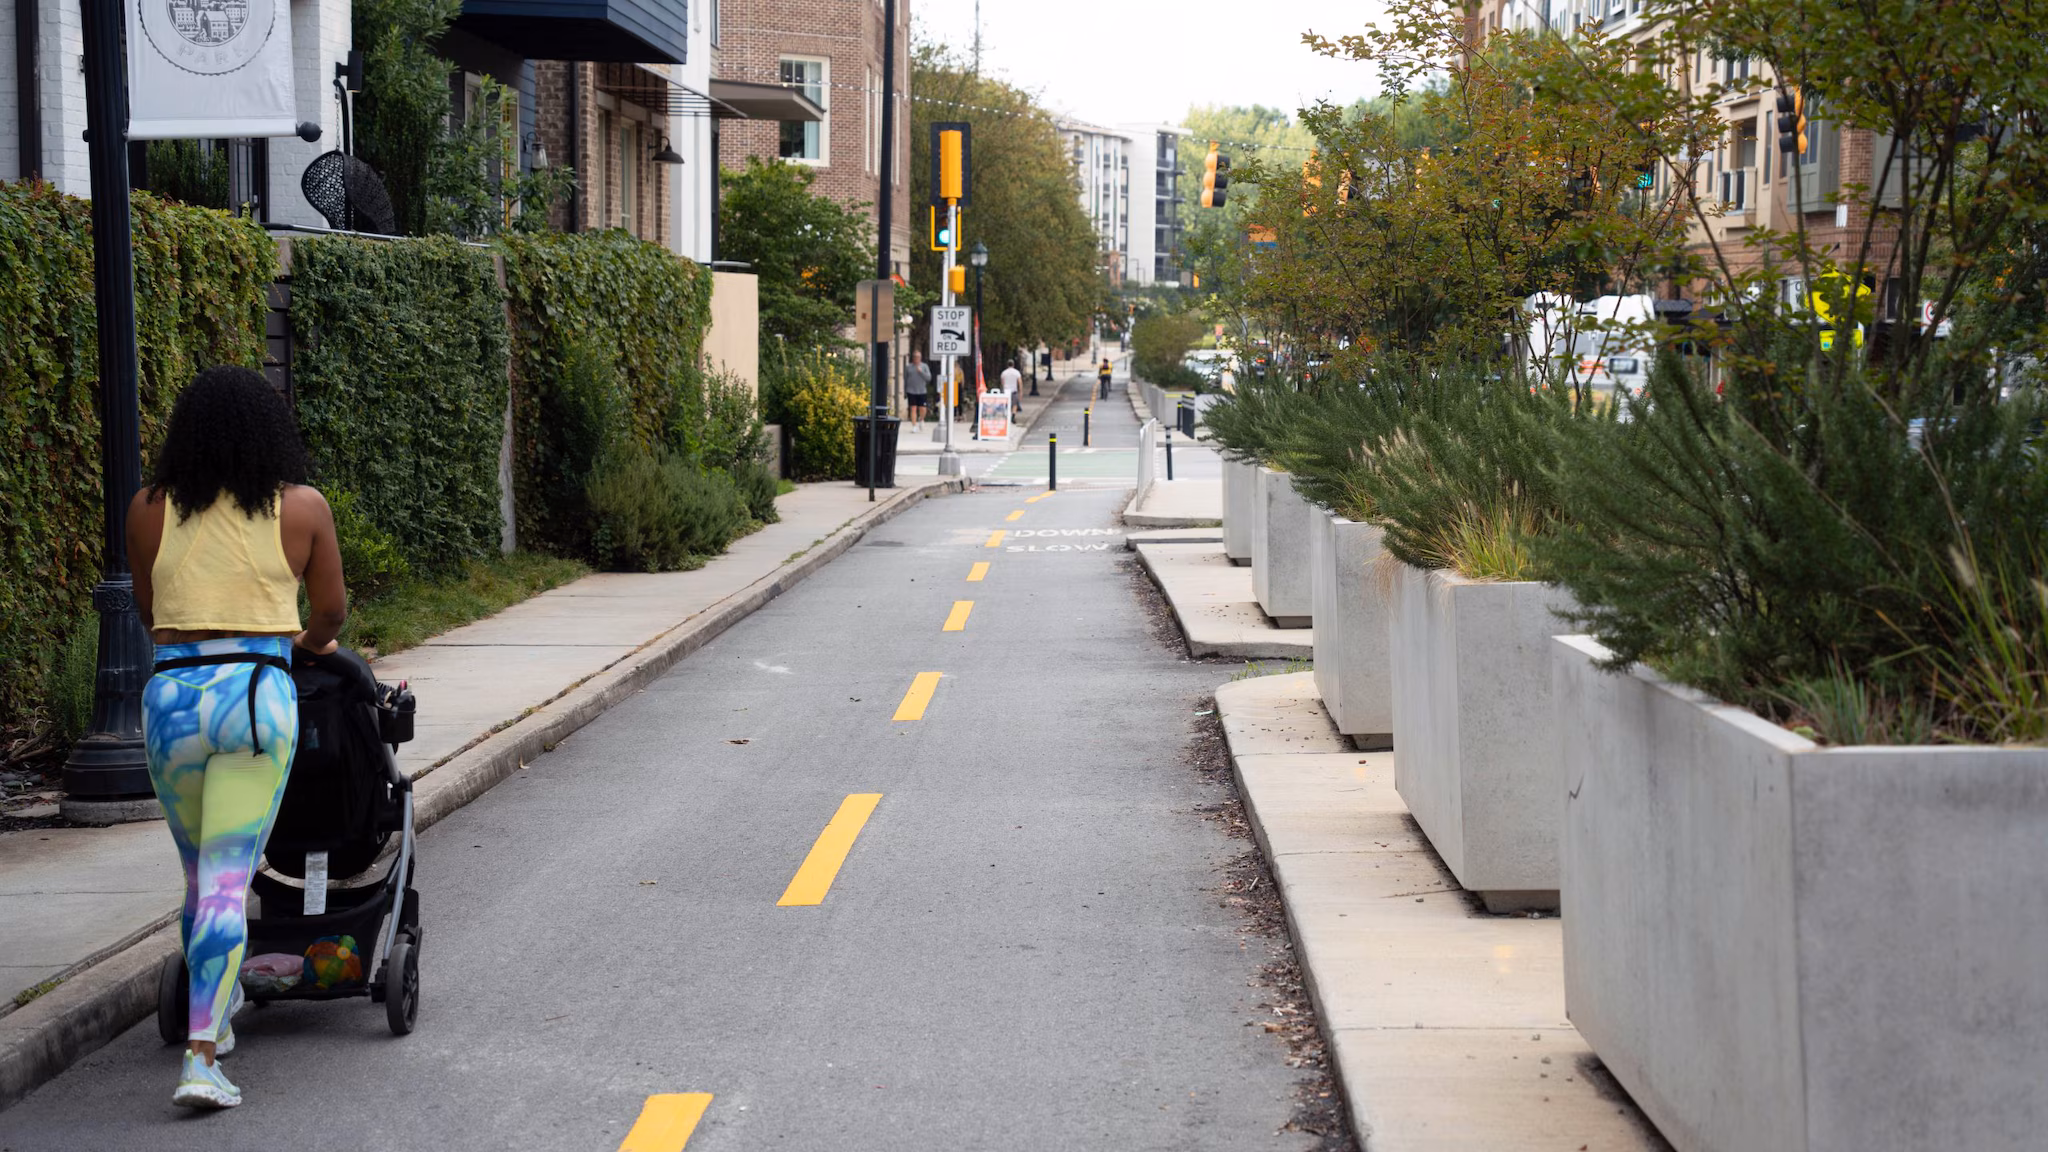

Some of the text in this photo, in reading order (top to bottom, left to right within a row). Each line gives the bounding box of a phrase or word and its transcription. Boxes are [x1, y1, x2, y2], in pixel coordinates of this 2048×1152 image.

[937, 310, 965, 320] STOP
[937, 341, 958, 351] RED
[1014, 528, 1114, 537] DOWN
[1006, 543, 1109, 553] SLOW
